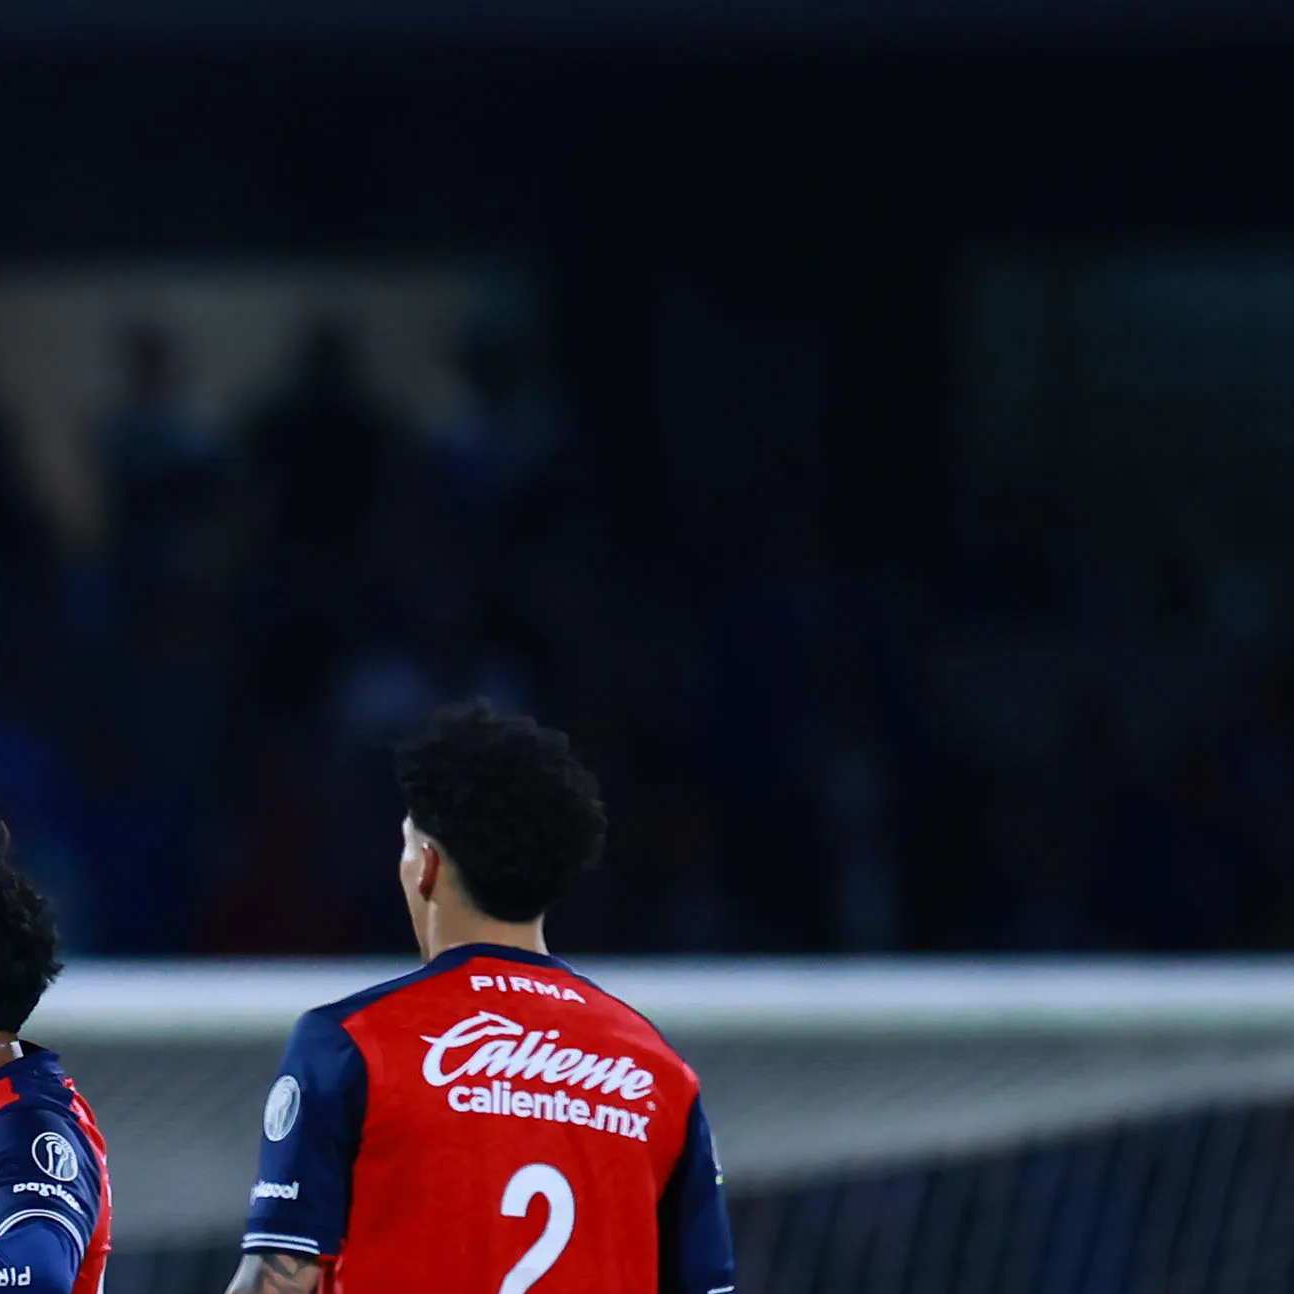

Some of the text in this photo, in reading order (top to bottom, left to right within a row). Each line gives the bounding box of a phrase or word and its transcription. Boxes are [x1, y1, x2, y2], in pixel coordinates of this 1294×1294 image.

[470, 975, 587, 1004] PIRMA
[420, 1010, 654, 1100] Caliente
[447, 1080, 650, 1142] caliente.mx
